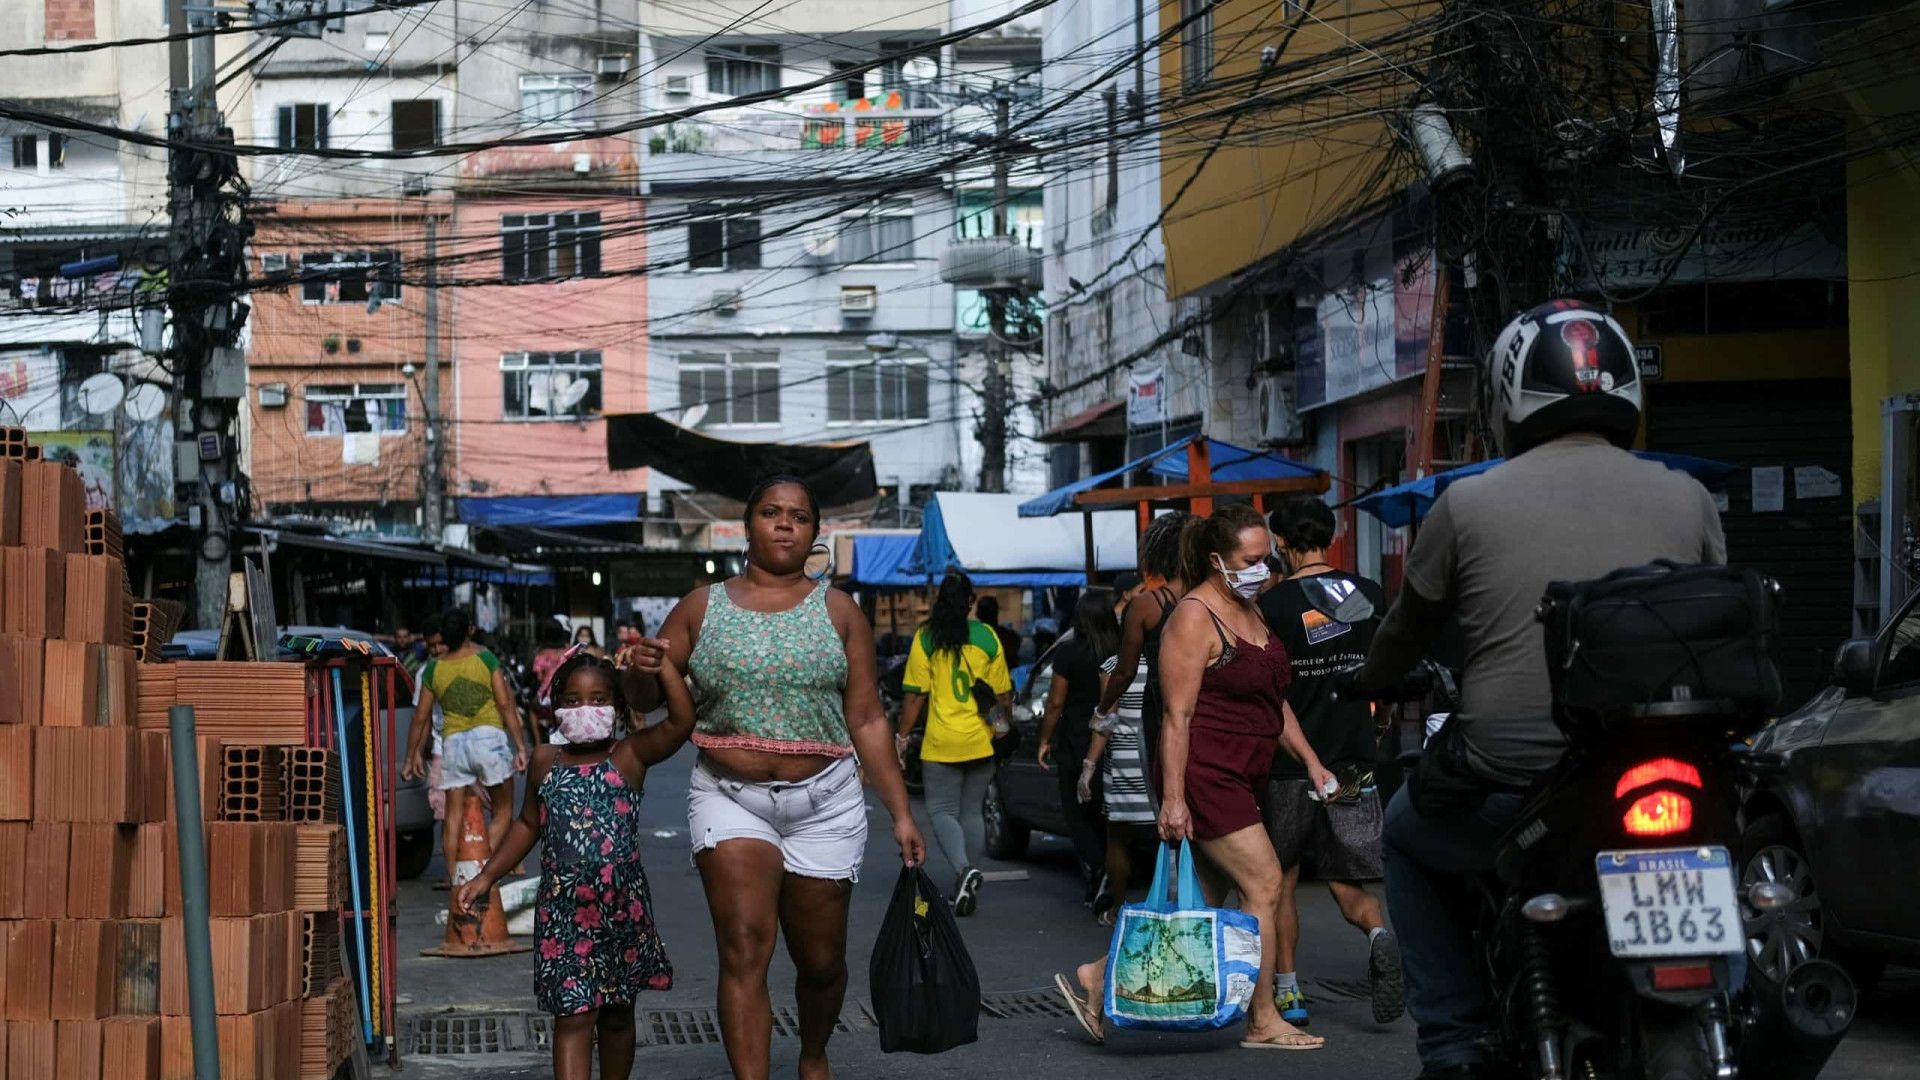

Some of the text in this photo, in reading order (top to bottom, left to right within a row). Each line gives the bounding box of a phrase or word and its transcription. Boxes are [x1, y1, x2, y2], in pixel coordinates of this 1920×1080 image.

[952, 655, 970, 703] 6
[1638, 858, 1689, 872] BRASIL
[1629, 870, 1706, 907] LMW
[1623, 907, 1726, 945] 1B63
